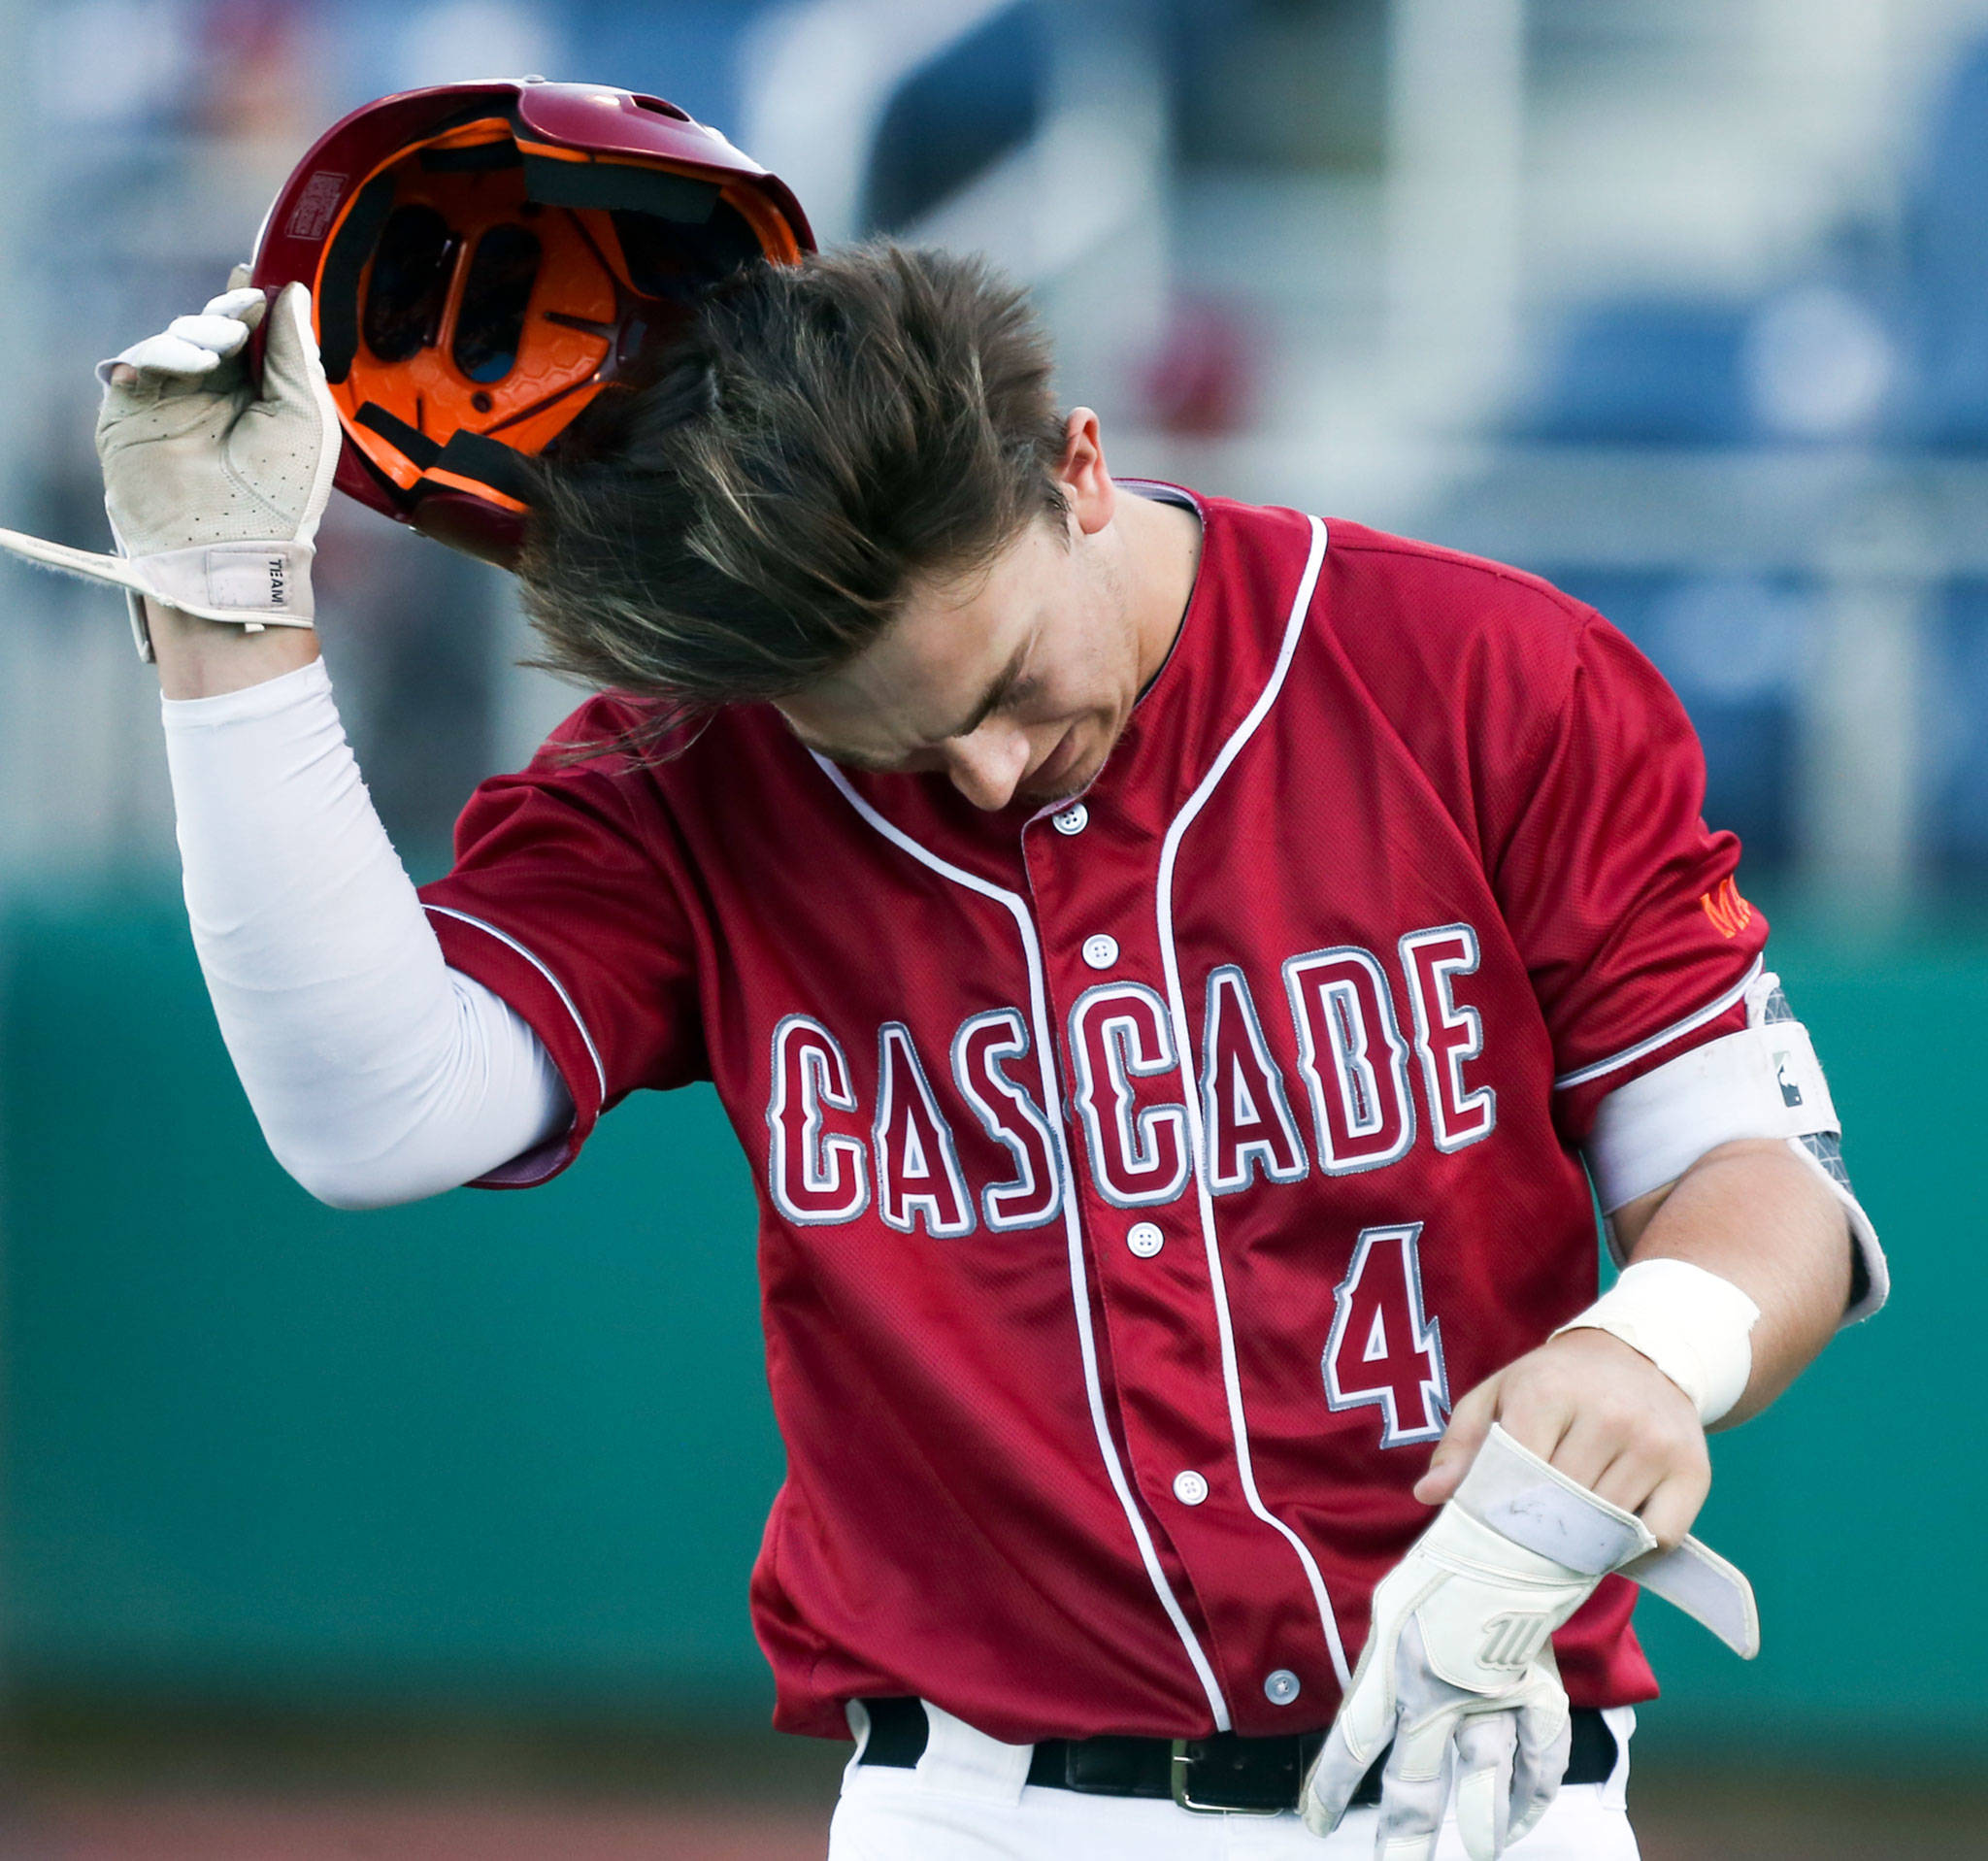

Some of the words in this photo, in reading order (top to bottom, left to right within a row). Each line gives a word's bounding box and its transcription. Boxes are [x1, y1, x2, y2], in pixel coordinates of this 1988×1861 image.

[269, 559, 283, 603] TEAM
[767, 922, 1497, 1239] CASCADE
[1321, 1221, 1451, 1450] 4
